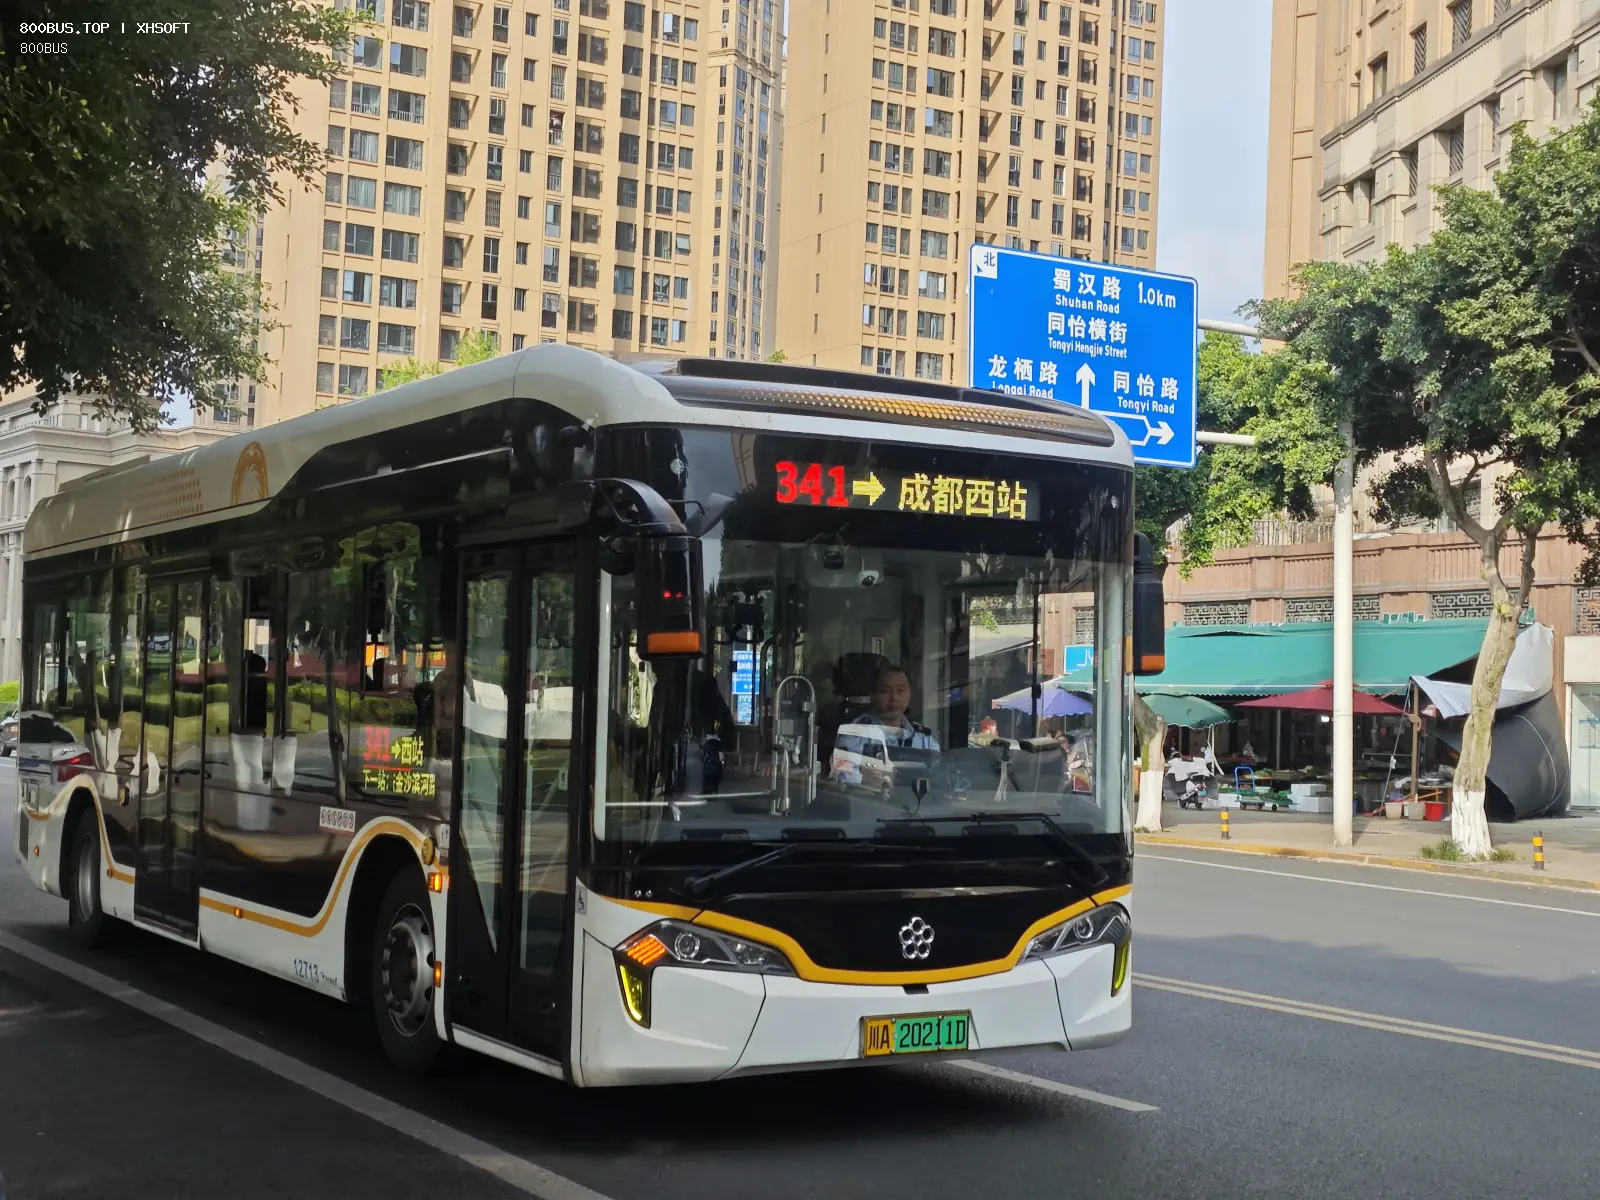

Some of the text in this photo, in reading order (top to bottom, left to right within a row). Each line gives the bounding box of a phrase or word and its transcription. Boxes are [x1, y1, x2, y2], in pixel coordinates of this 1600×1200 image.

[983, 251, 996, 267] 北
[1052, 268, 1177, 309] 蜀汉路 1.0km
[1055, 294, 1120, 314] Shuhan Road
[1047, 311, 1128, 345] 同怡横街
[1048, 336, 1128, 359] Tongyi Hengjie Street
[988, 354, 1059, 386] 龙栖路
[1029, 385, 1054, 399] Road
[1113, 370, 1179, 401] 同怡路
[1117, 396, 1175, 414] Tongyi Road
[775, 460, 1028, 520] 341 成都西站
[363, 725, 425, 766] 341 西站
[293, 957, 320, 984] 12713
